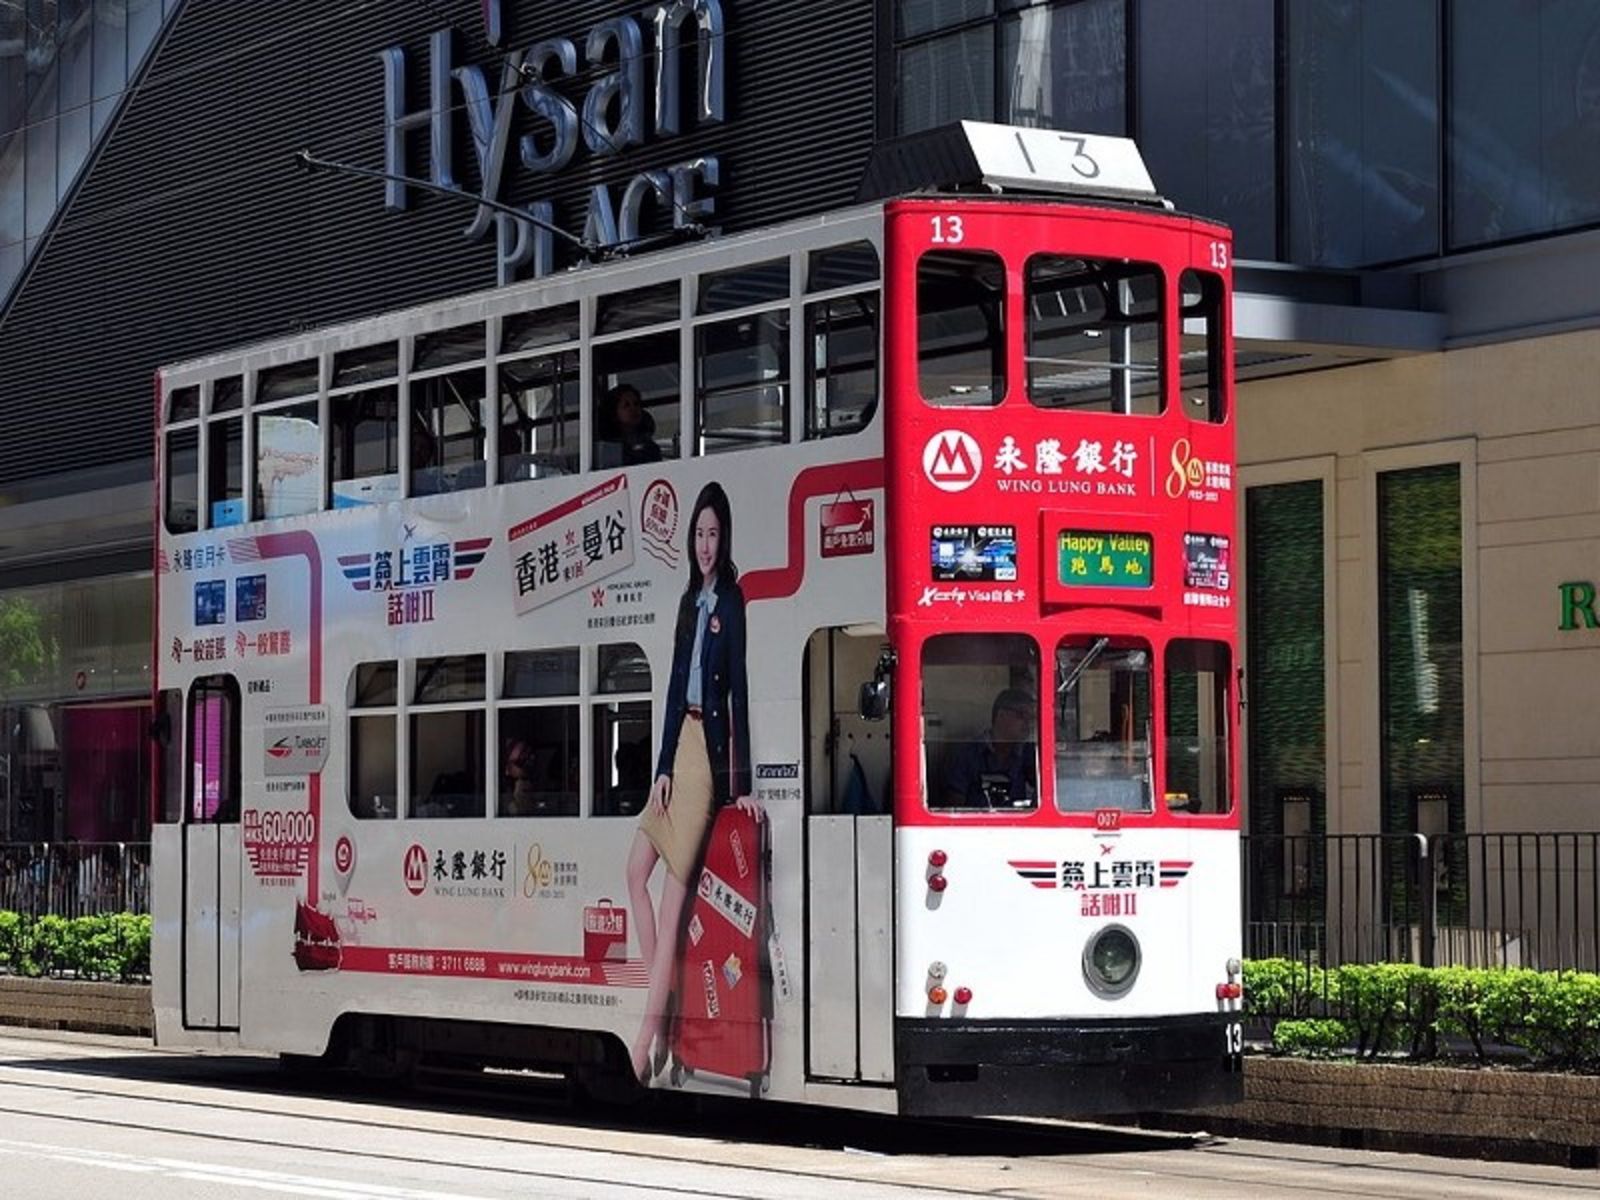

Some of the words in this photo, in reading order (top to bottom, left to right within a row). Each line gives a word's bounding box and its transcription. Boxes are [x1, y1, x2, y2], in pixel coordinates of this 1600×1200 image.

[382, 0, 724, 238] Hysan
[930, 215, 964, 244] 13
[1209, 241, 1228, 269] 13
[993, 435, 1138, 478] 永隆銀行
[997, 479, 1041, 493] WING
[1048, 480, 1091, 494] LUNG
[1096, 480, 1137, 496] BANK
[514, 541, 561, 597] 香港
[582, 509, 626, 567] 曼谷
[1061, 533, 1104, 555] Happy
[1109, 534, 1150, 557] Valley
[1070, 555, 1144, 576] 跑馬地
[432, 849, 507, 882] 永隆銀行
[1061, 860, 1155, 891] 簽上雲霄
[433, 886, 455, 897] WING
[457, 886, 480, 898] LUNG
[482, 886, 506, 898] BANK
[498, 961, 591, 980] www.winglungbank.com
[1225, 1023, 1242, 1053] 13
